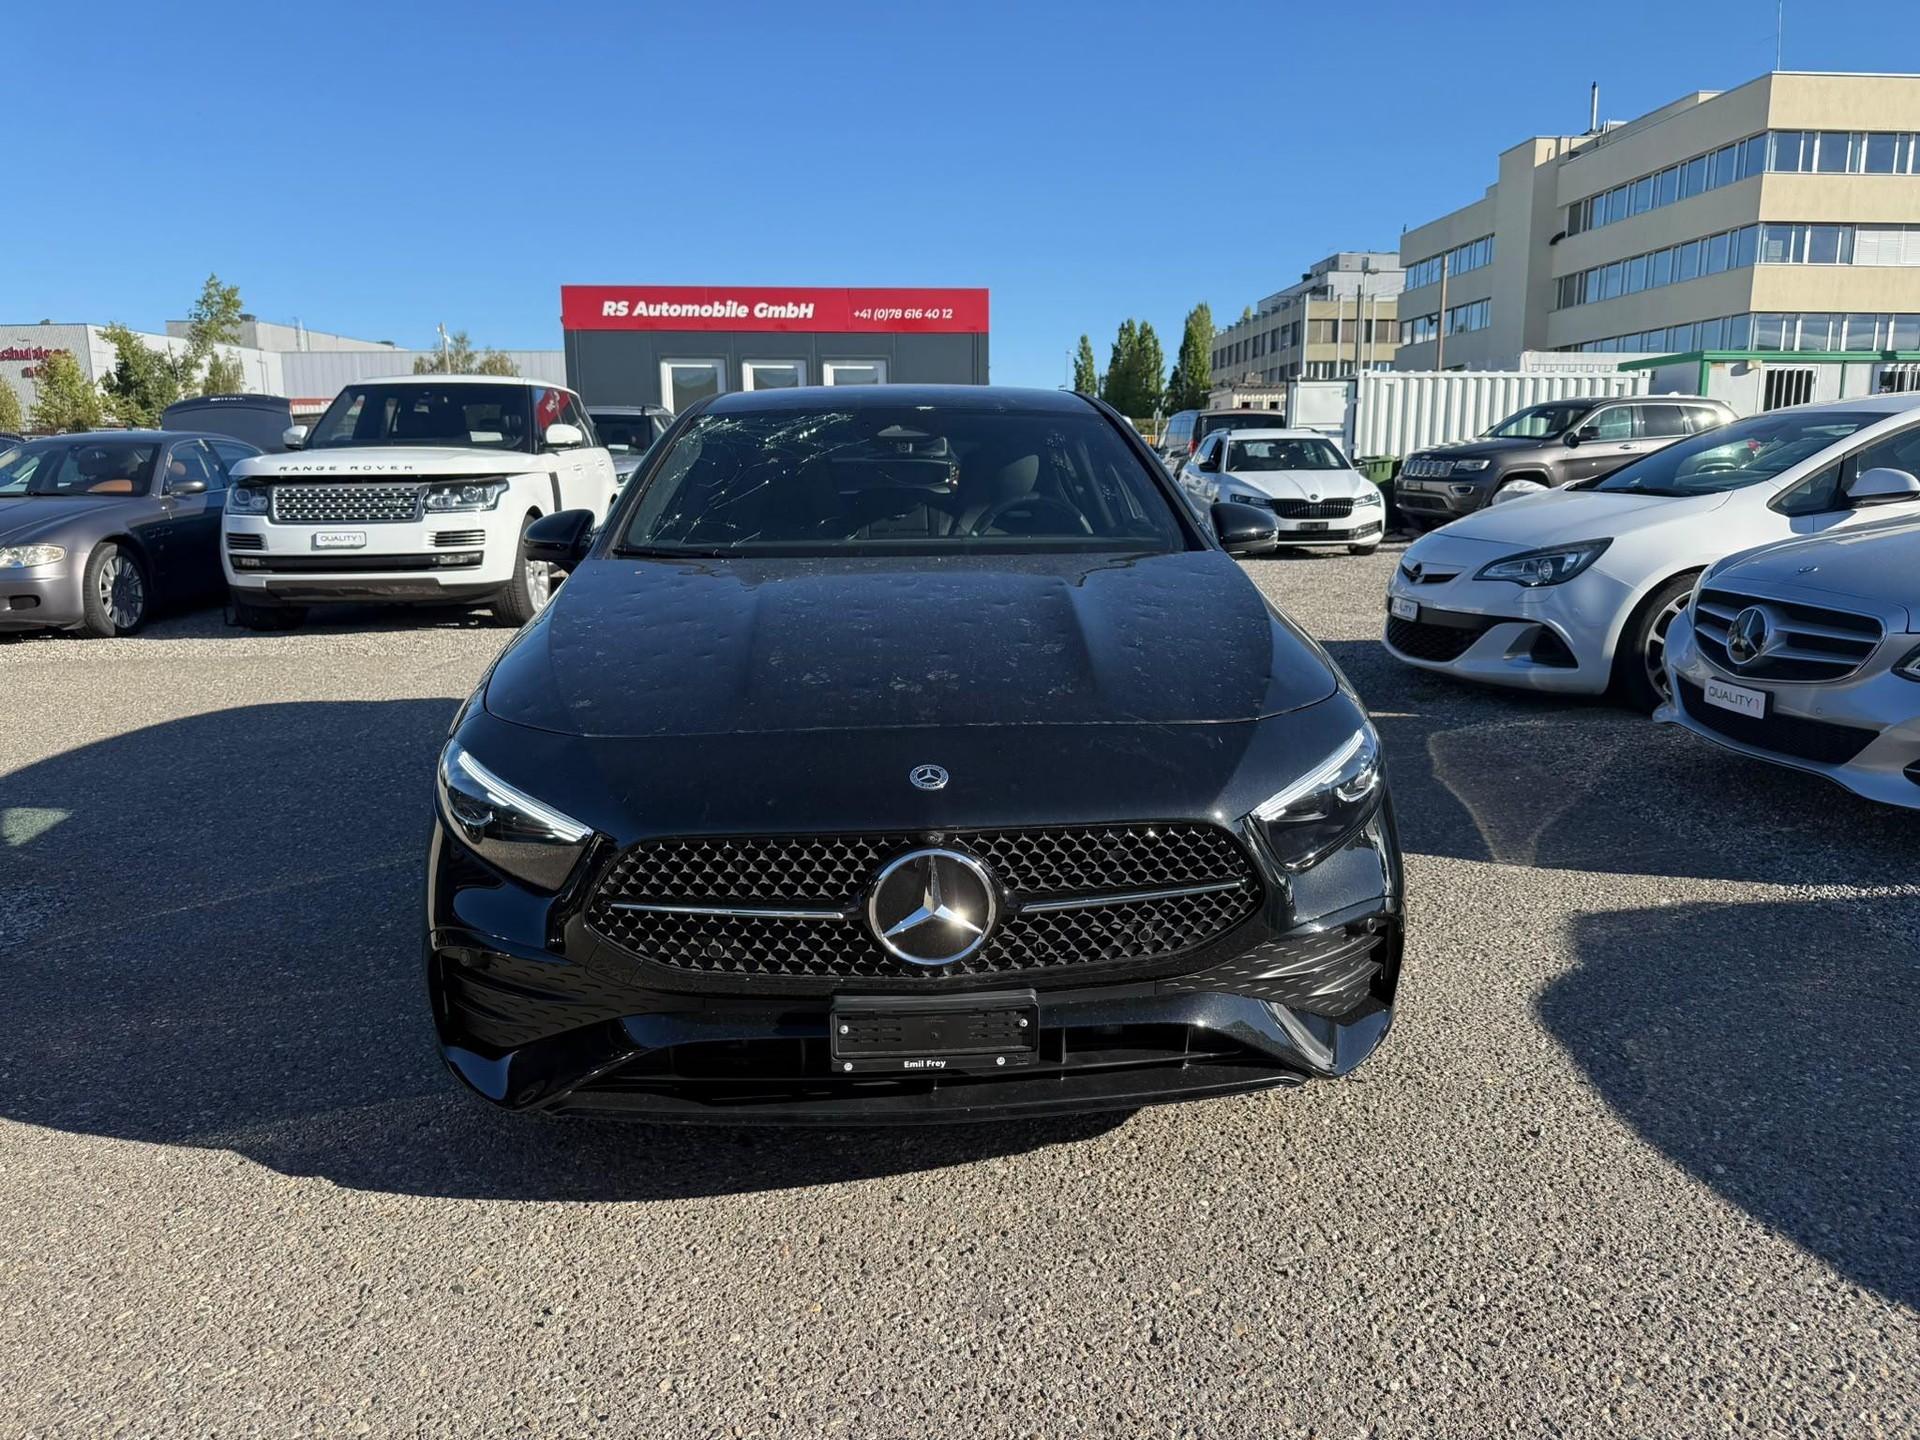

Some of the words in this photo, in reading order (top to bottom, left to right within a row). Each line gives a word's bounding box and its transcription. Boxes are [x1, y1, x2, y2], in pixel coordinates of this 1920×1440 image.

[602, 301, 629, 317] RS
[632, 300, 749, 318] Automobile
[753, 302, 815, 319] GmbH
[853, 308, 872, 319] +41
[873, 308, 902, 321] (0)78
[904, 308, 923, 319] 616
[924, 308, 940, 319] 40
[941, 308, 953, 319] 12
[904, 1060, 924, 1068] Emil
[926, 1060, 946, 1068] Frey
